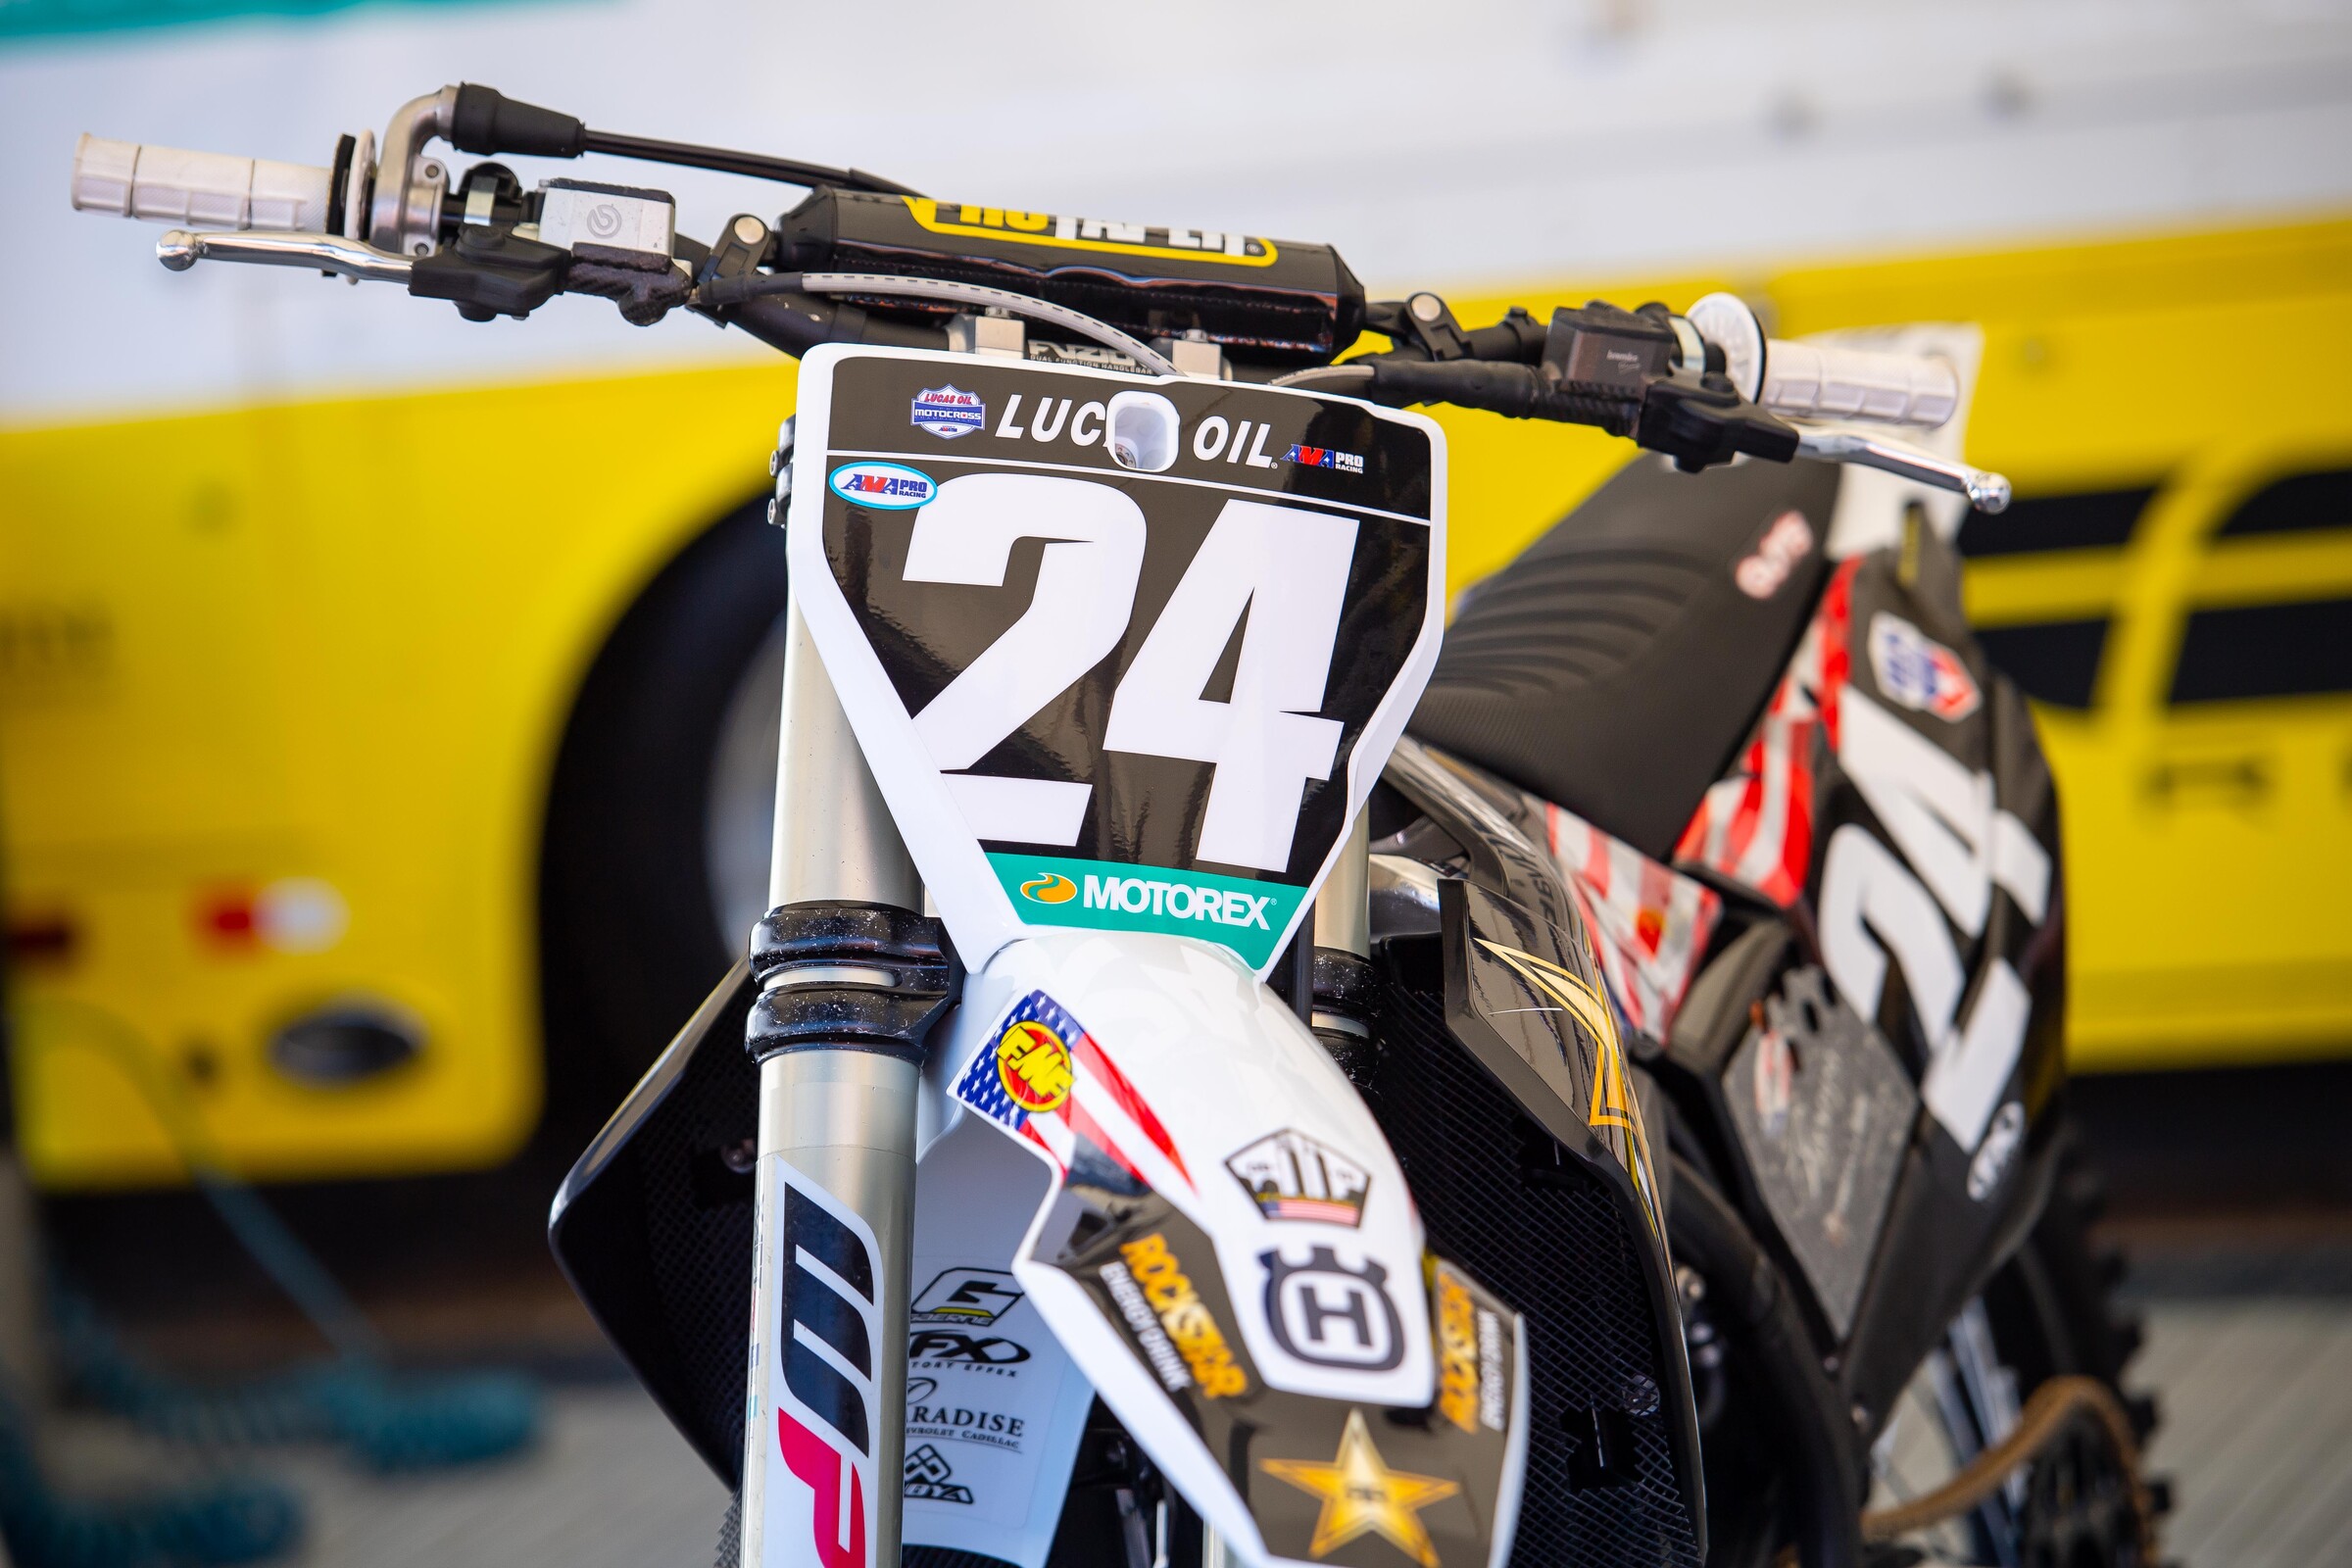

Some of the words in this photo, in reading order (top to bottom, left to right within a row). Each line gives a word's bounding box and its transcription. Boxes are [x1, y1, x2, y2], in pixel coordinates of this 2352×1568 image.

[914, 409, 981, 420] MOTOCROSS
[924, 393, 956, 404] LUCAS
[956, 395, 973, 405] OIL
[1280, 443, 1334, 469] AMA
[1335, 451, 1363, 467] PRO
[1335, 463, 1363, 474] RACING
[841, 473, 899, 496] AMA
[900, 479, 928, 493] PRO
[899, 490, 927, 499] RACING
[902, 473, 1360, 874] 24
[1083, 874, 1271, 931] MOTOREX
[1820, 684, 2052, 1153] 24
[996, 1025, 1076, 1099] FMF
[1099, 1261, 1157, 1332] ENERGY
[1137, 1326, 1193, 1393] DRINK
[1119, 1232, 1249, 1399] ROCKSTAR
[906, 1405, 1025, 1438] RADISE
